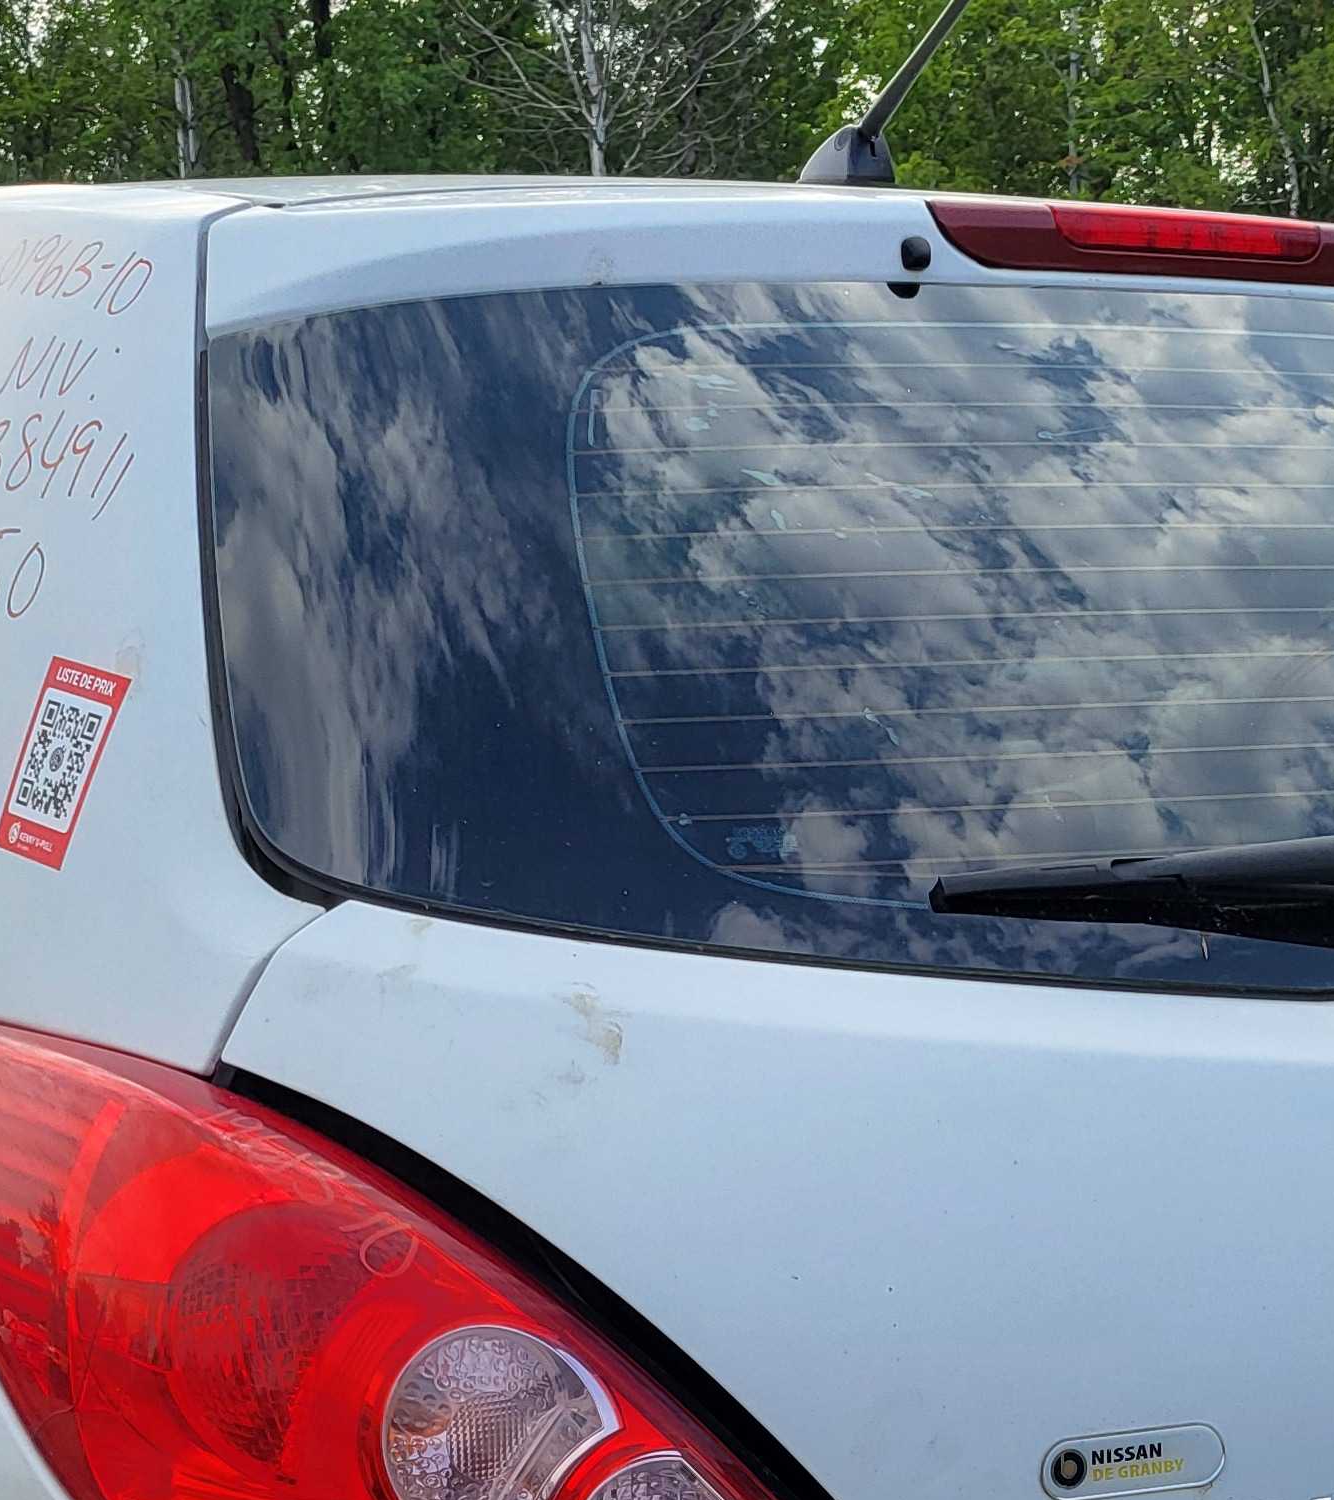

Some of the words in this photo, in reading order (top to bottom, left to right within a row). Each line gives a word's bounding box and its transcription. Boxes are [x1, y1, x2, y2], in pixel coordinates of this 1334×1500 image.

[56, 666, 80, 687] LISTE
[79, 672, 94, 691] DE
[93, 676, 117, 697] PRIX
[1091, 1442, 1163, 1466] NISSAN
[1092, 1465, 1114, 1482] DE
[1117, 1457, 1185, 1479] GRANBY
